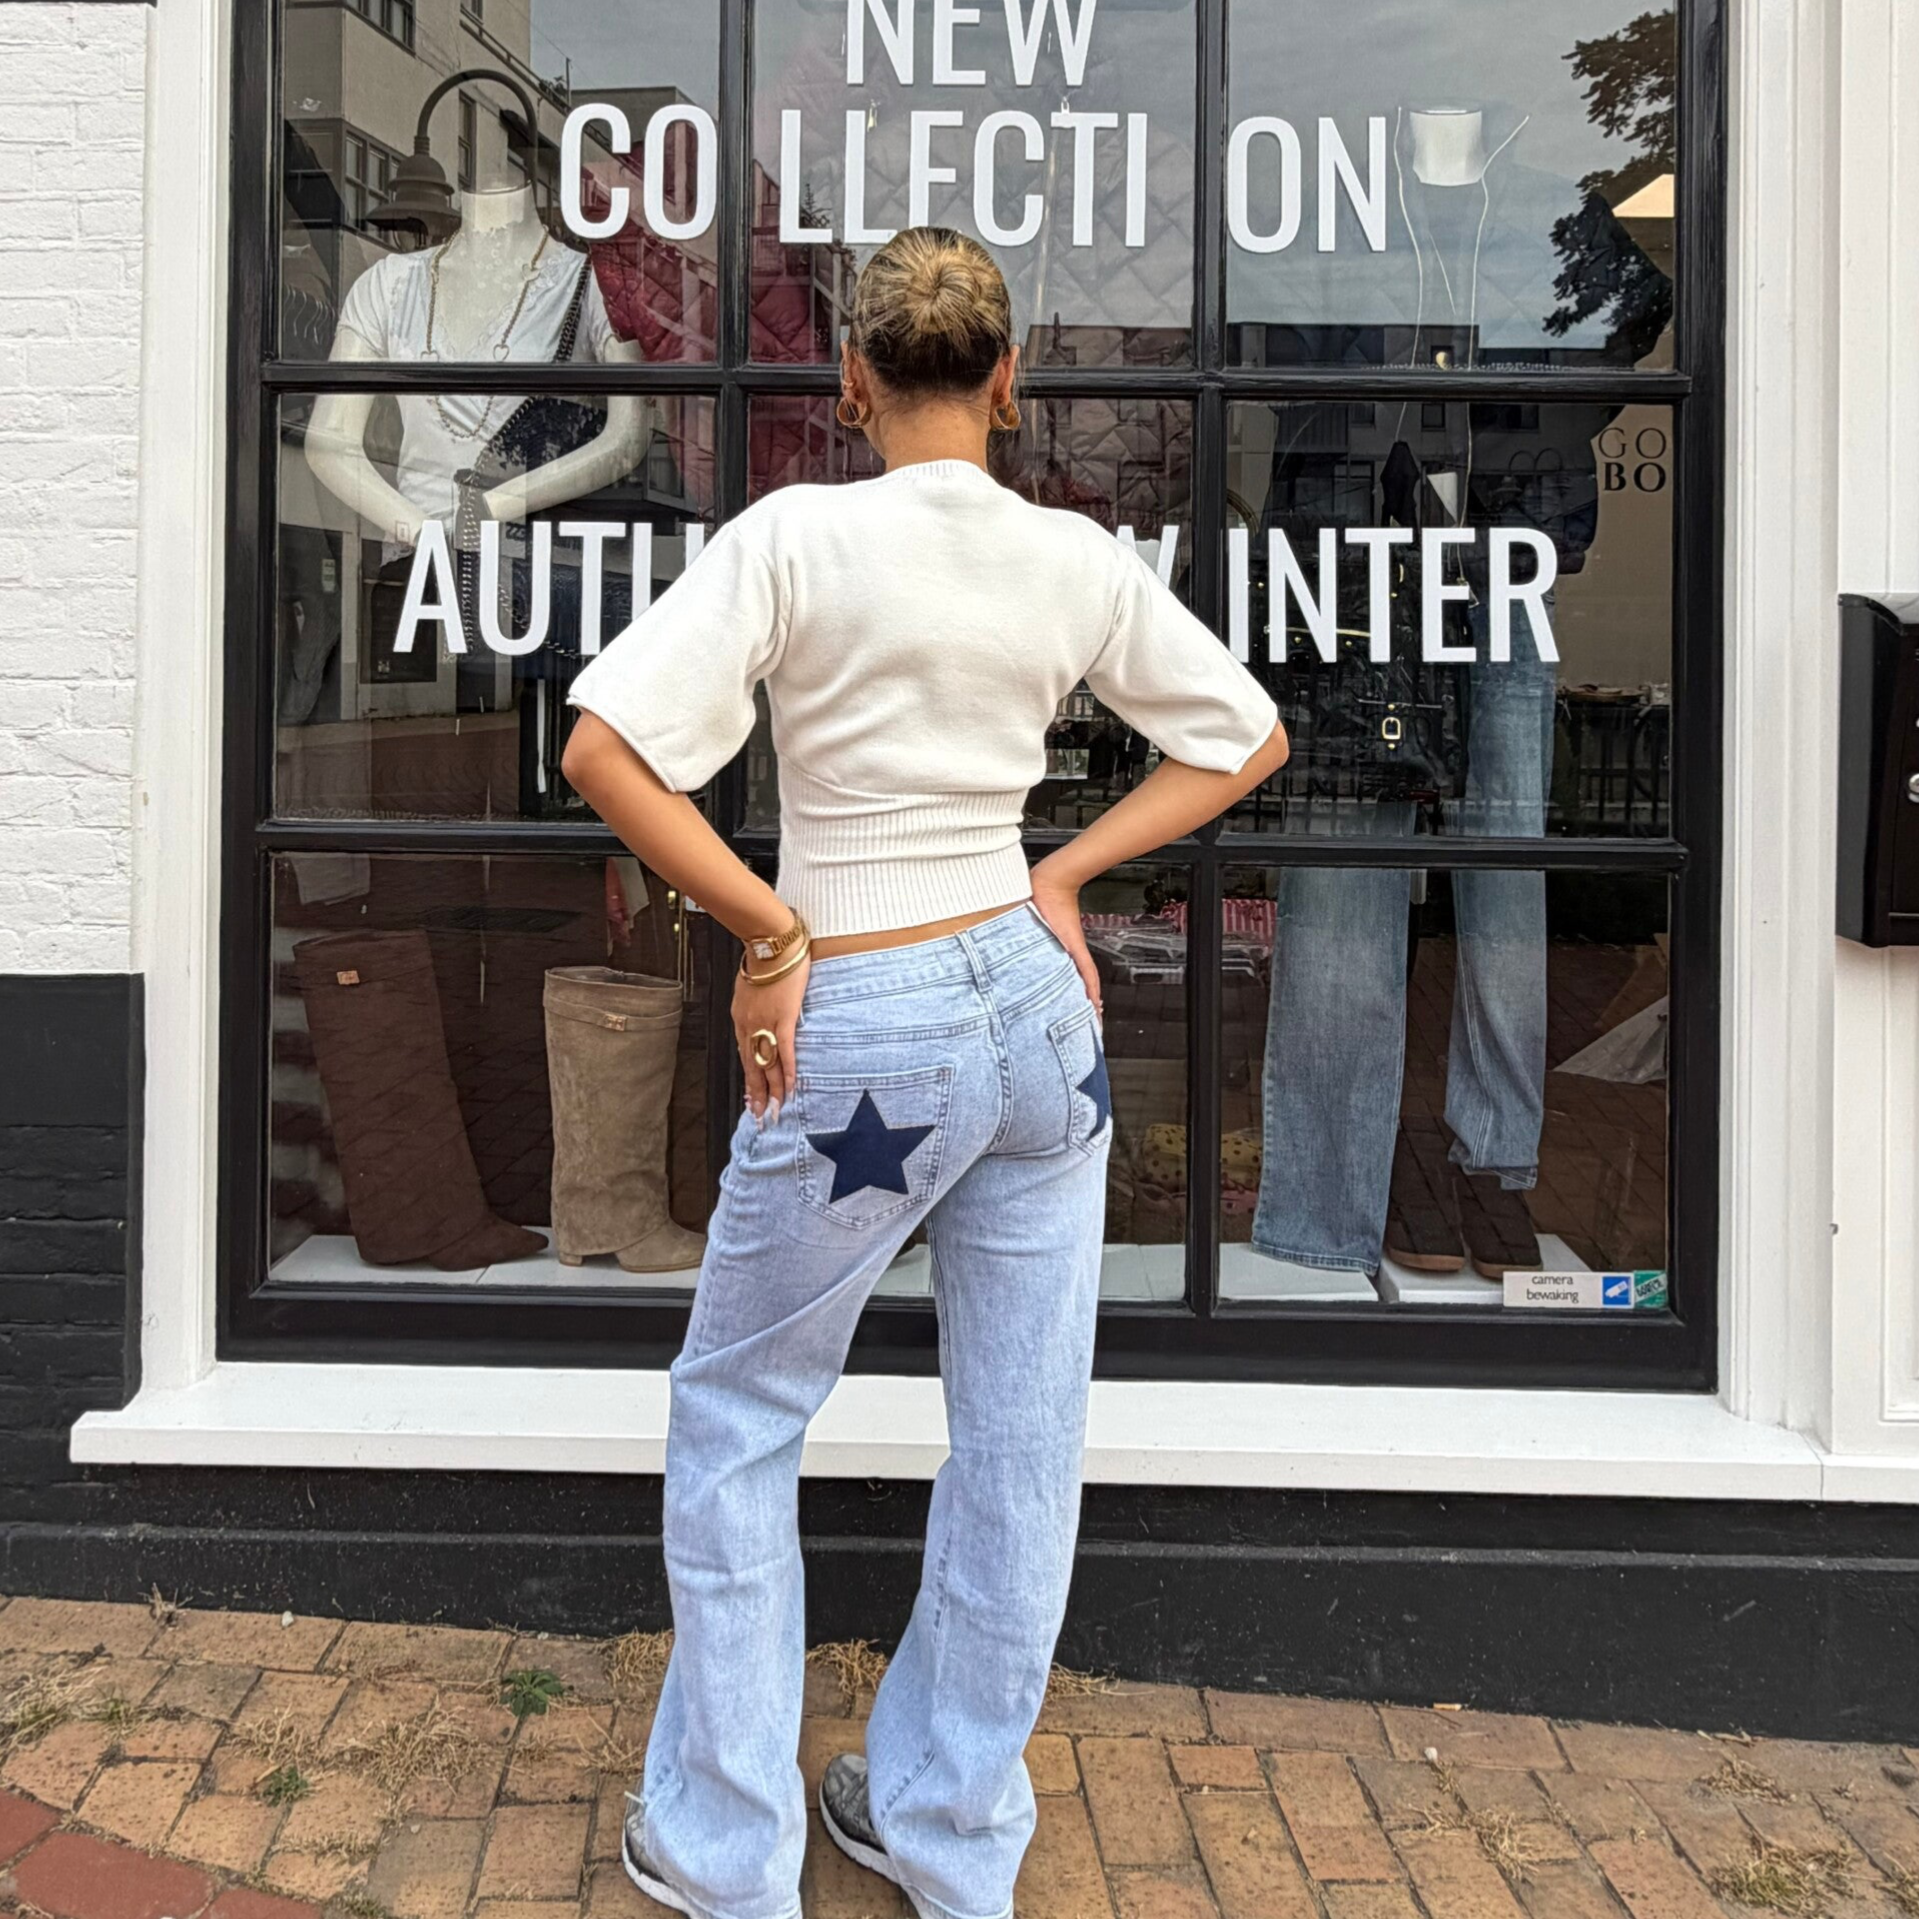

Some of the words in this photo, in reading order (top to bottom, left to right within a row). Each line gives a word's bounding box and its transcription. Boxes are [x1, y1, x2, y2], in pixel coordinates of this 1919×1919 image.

[846, 0, 1098, 86] NEW
[1598, 427, 1667, 460] GO
[1602, 461, 1667, 494] BO
[1116, 524, 1560, 664] INTER
[1526, 1288, 1580, 1304] bewaking
[1531, 1274, 1574, 1286] camera
